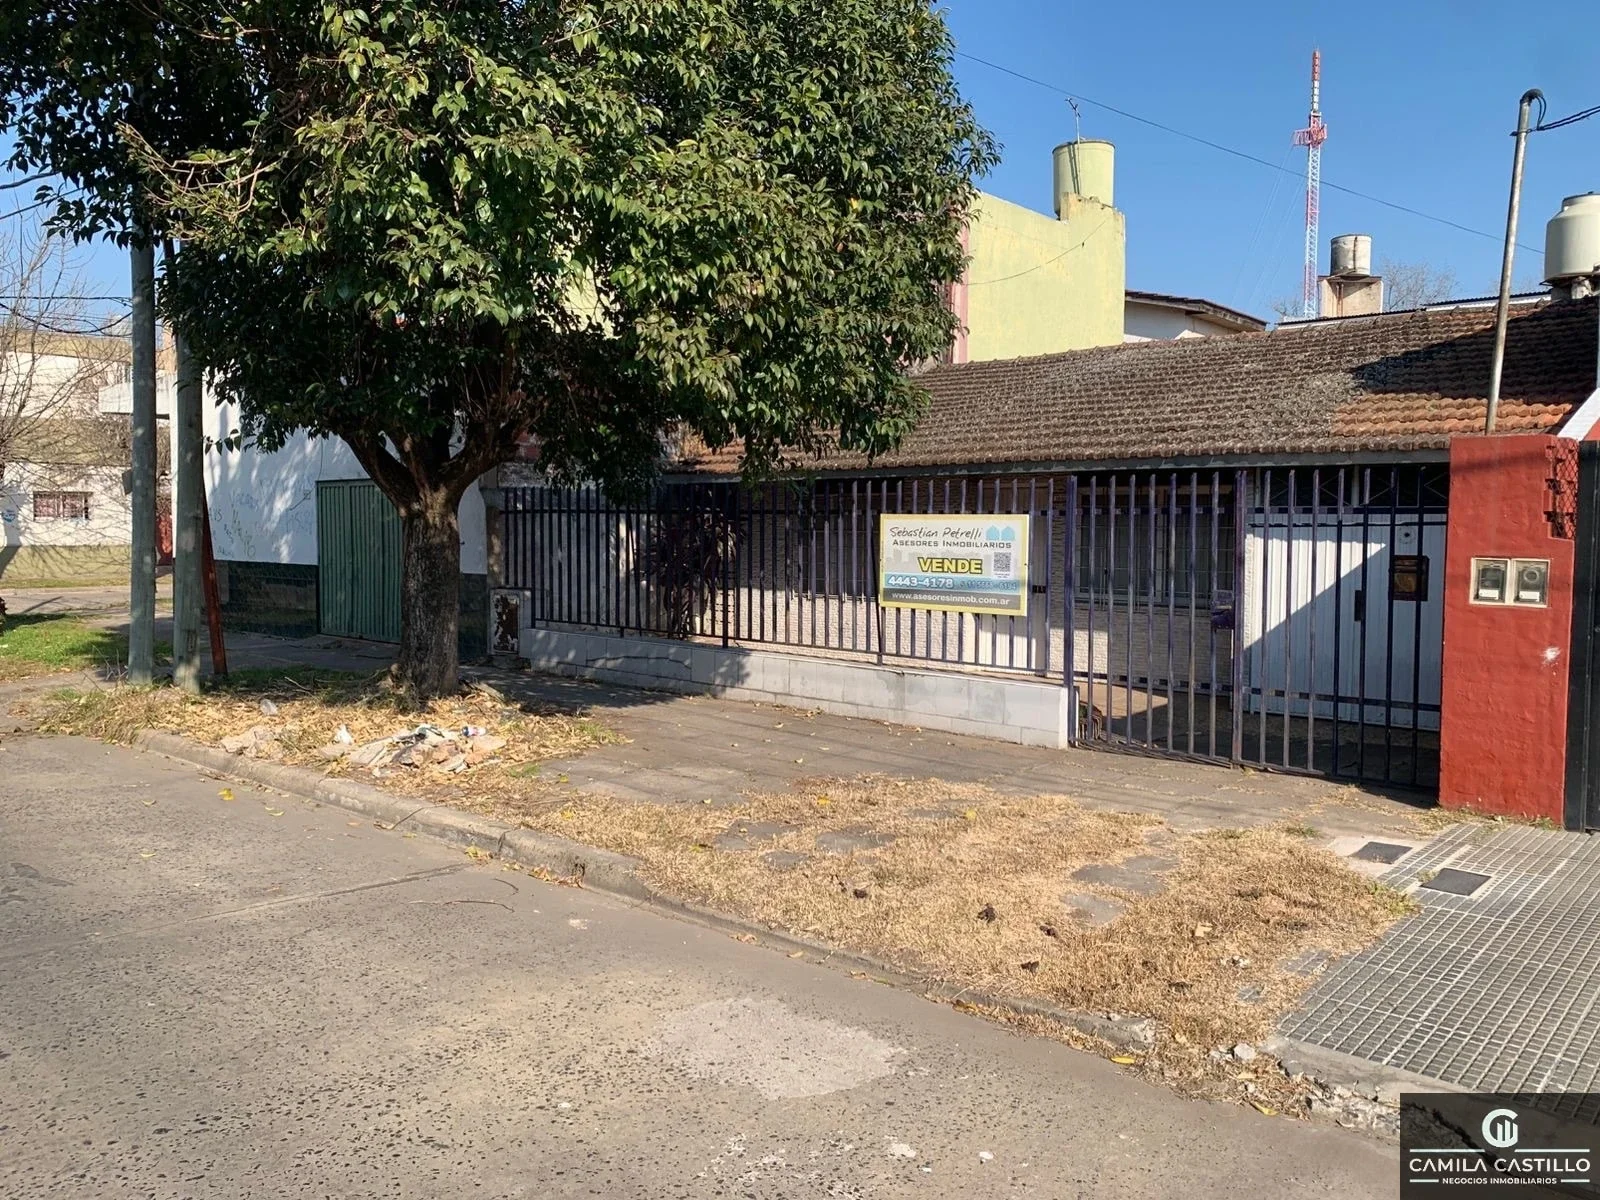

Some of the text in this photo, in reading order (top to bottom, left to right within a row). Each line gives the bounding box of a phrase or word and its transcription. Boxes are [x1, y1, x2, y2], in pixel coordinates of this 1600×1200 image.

[889, 526, 983, 540] Sebastian Petrelli
[892, 539, 1012, 549] ASESORES INMOBILIARIOS
[917, 556, 983, 574] VENDE
[888, 575, 955, 589] 4443-4178
[892, 592, 1010, 605] www.asesoresinmob.com.ar
